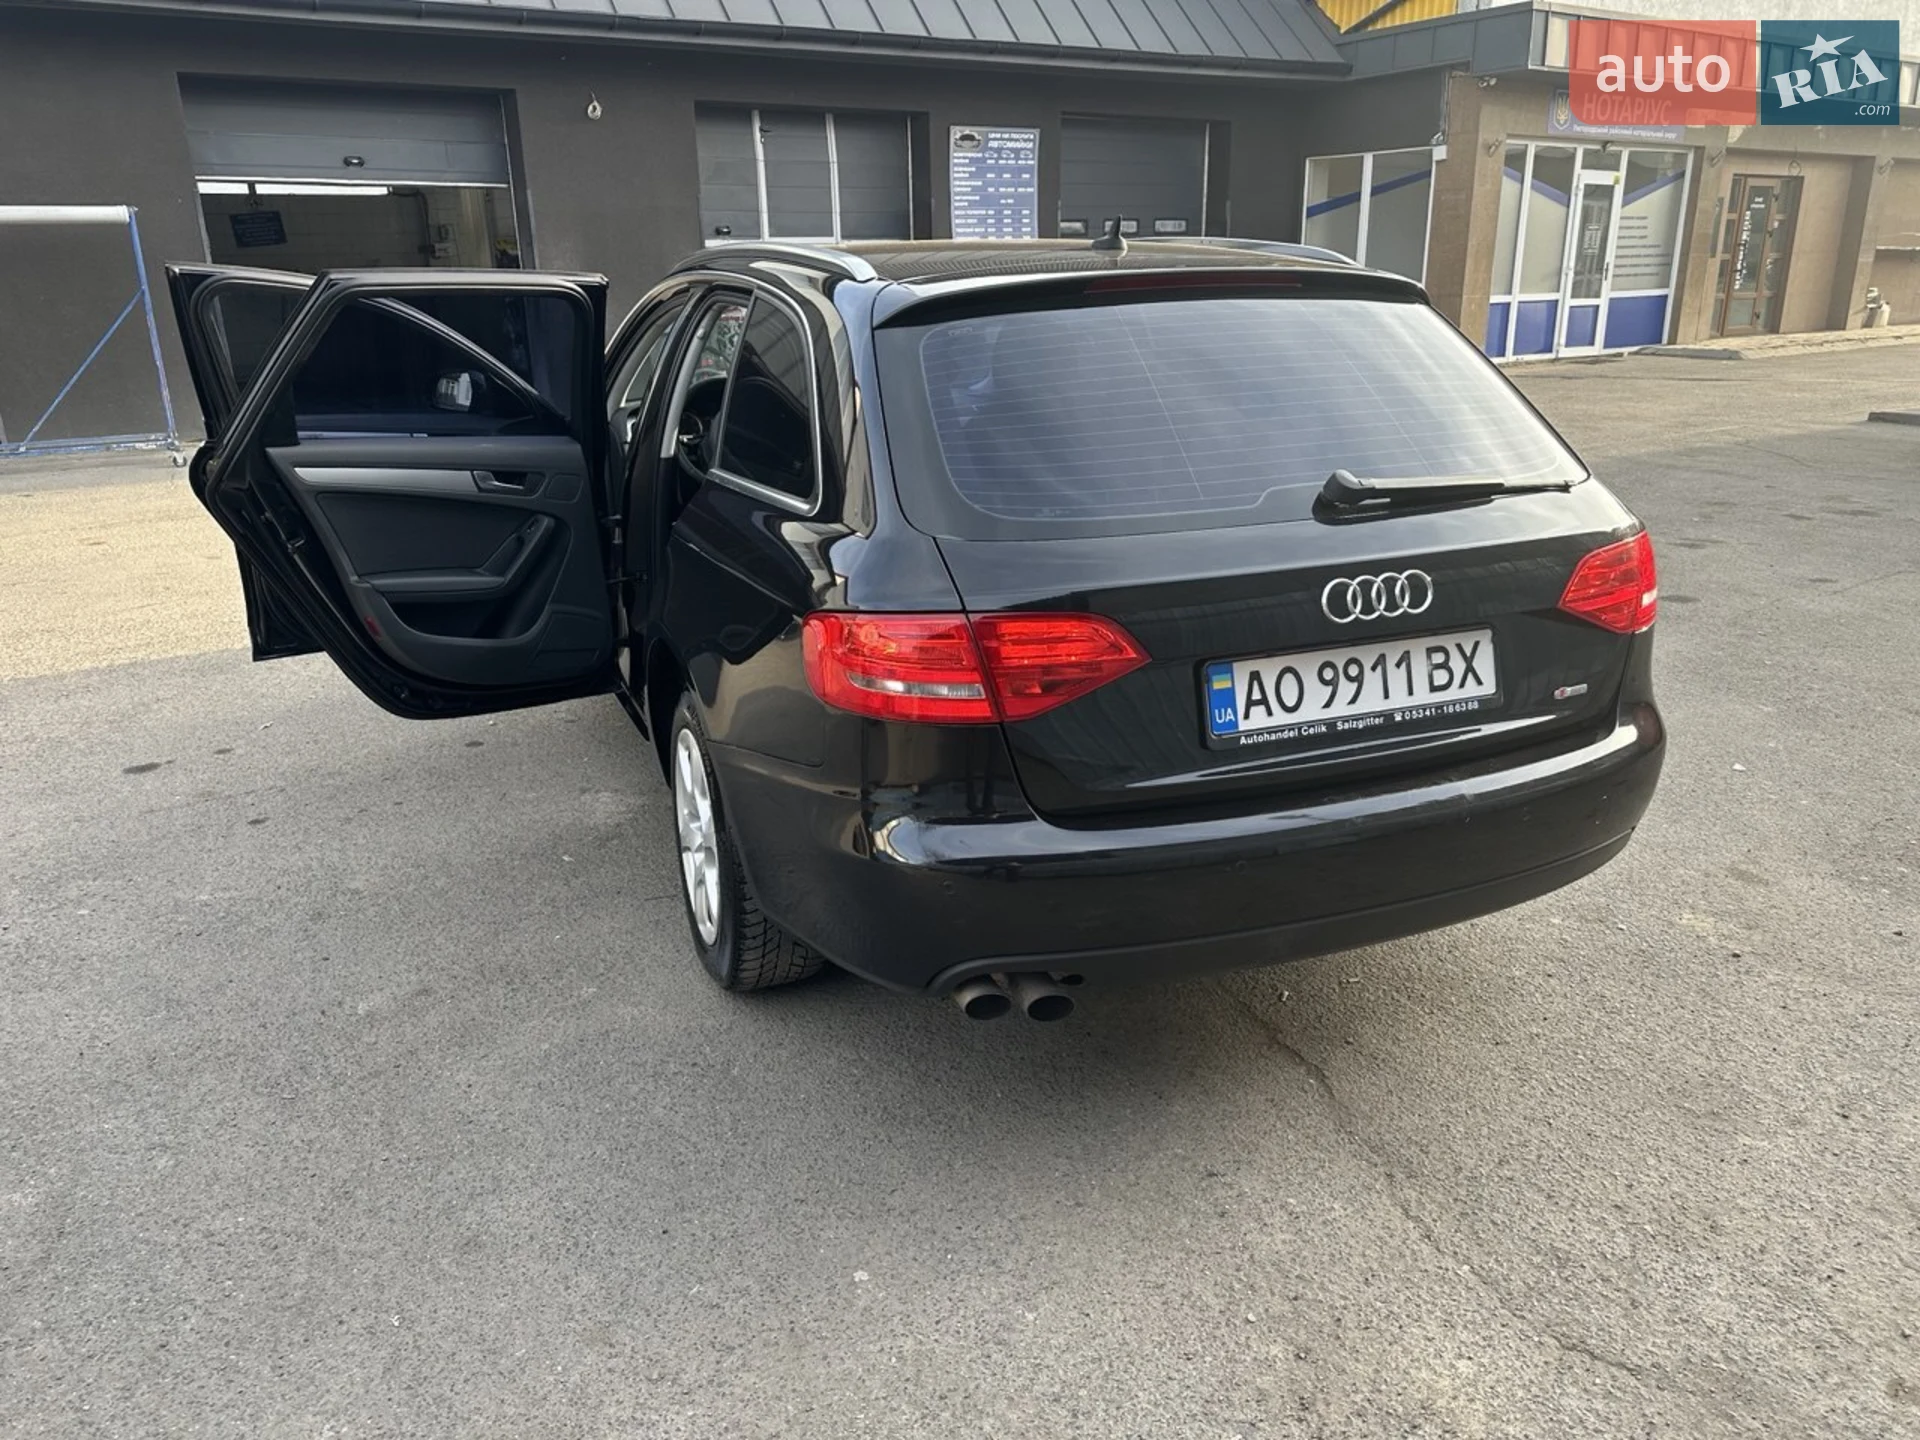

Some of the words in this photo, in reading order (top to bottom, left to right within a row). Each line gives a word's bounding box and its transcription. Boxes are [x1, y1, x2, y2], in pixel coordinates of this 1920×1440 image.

[1583, 93, 1672, 126] НОТАРІУС
[987, 139, 1034, 148] АВТОМИЙКИ
[1242, 665, 1305, 721] AO
[1316, 650, 1414, 710] 9911
[1425, 639, 1485, 694] BX
[1214, 708, 1235, 724] UA
[1239, 727, 1299, 746] Autohandel
[1300, 723, 1328, 736] Celik
[1336, 715, 1385, 731] Salzgitter
